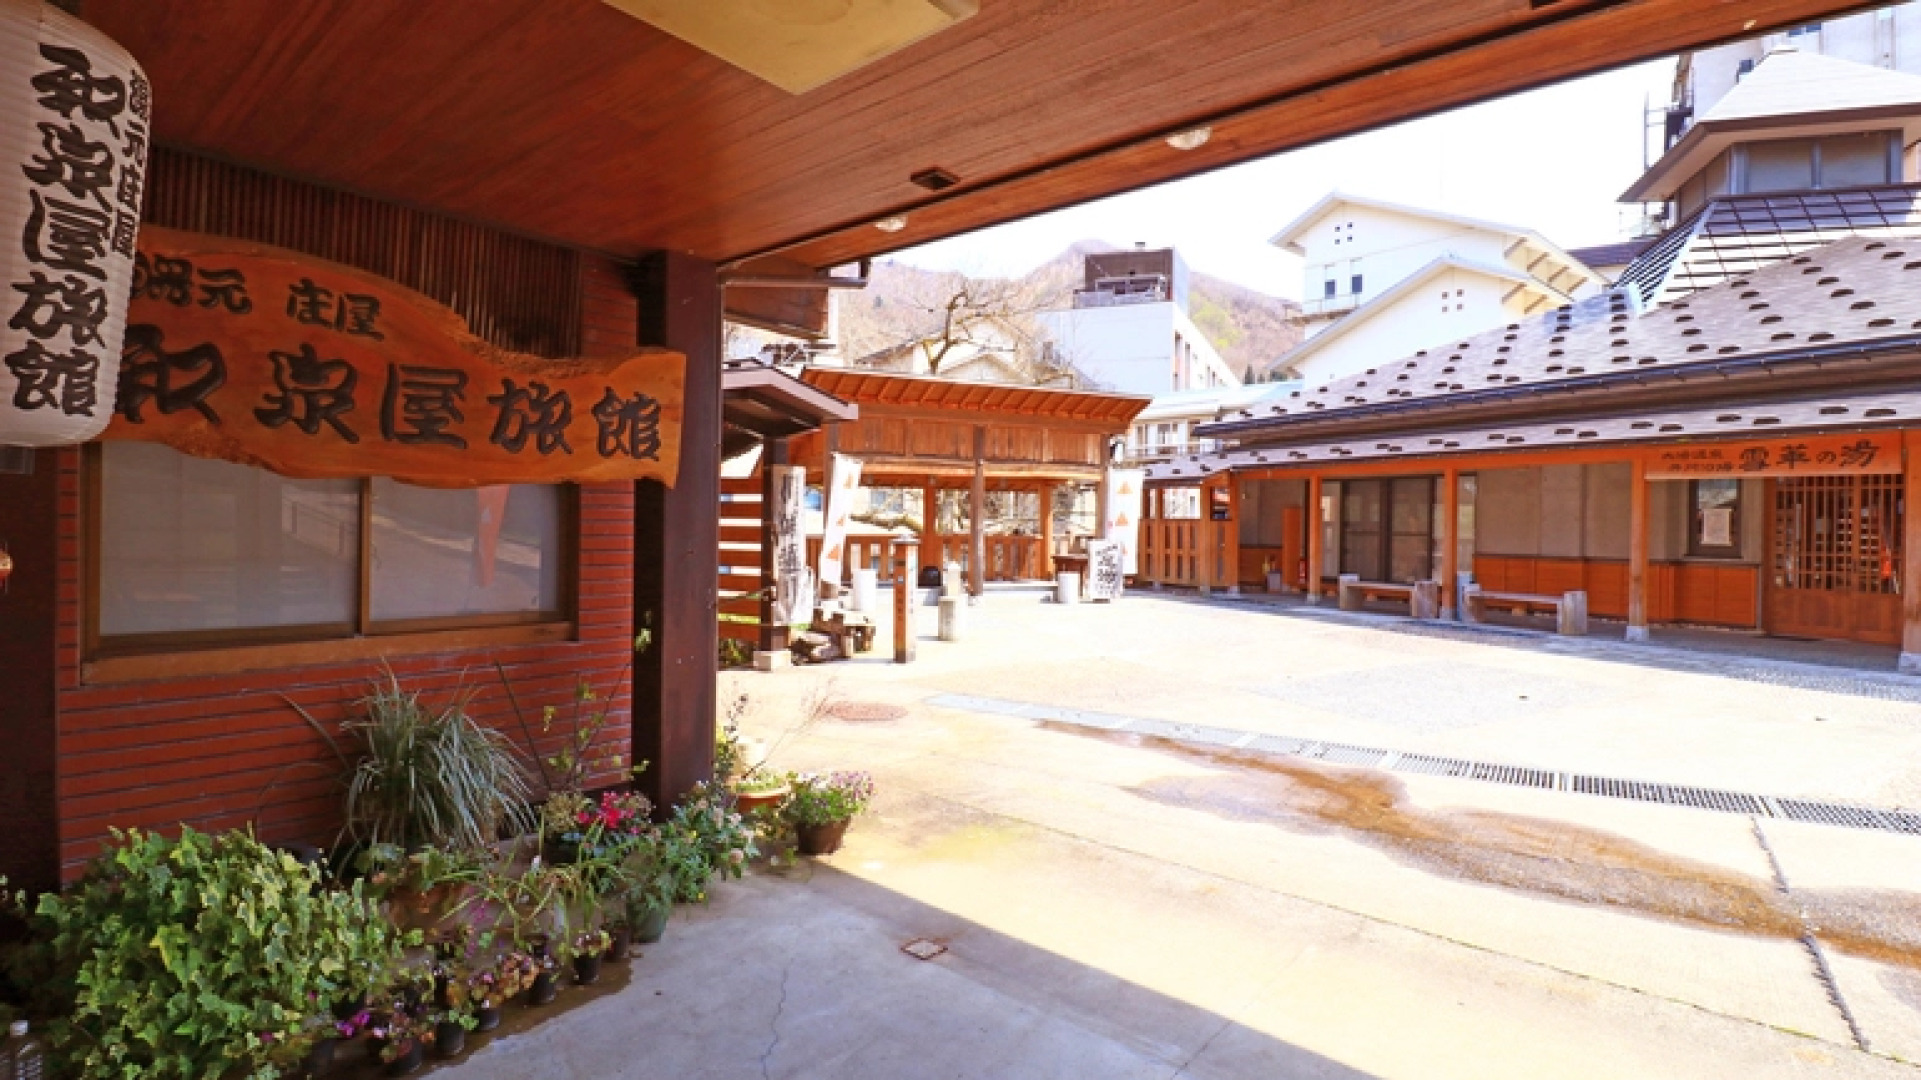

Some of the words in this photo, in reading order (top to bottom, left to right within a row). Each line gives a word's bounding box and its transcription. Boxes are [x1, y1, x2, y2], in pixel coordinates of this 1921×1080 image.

[6, 42, 125, 417] 和泉屋旅館
